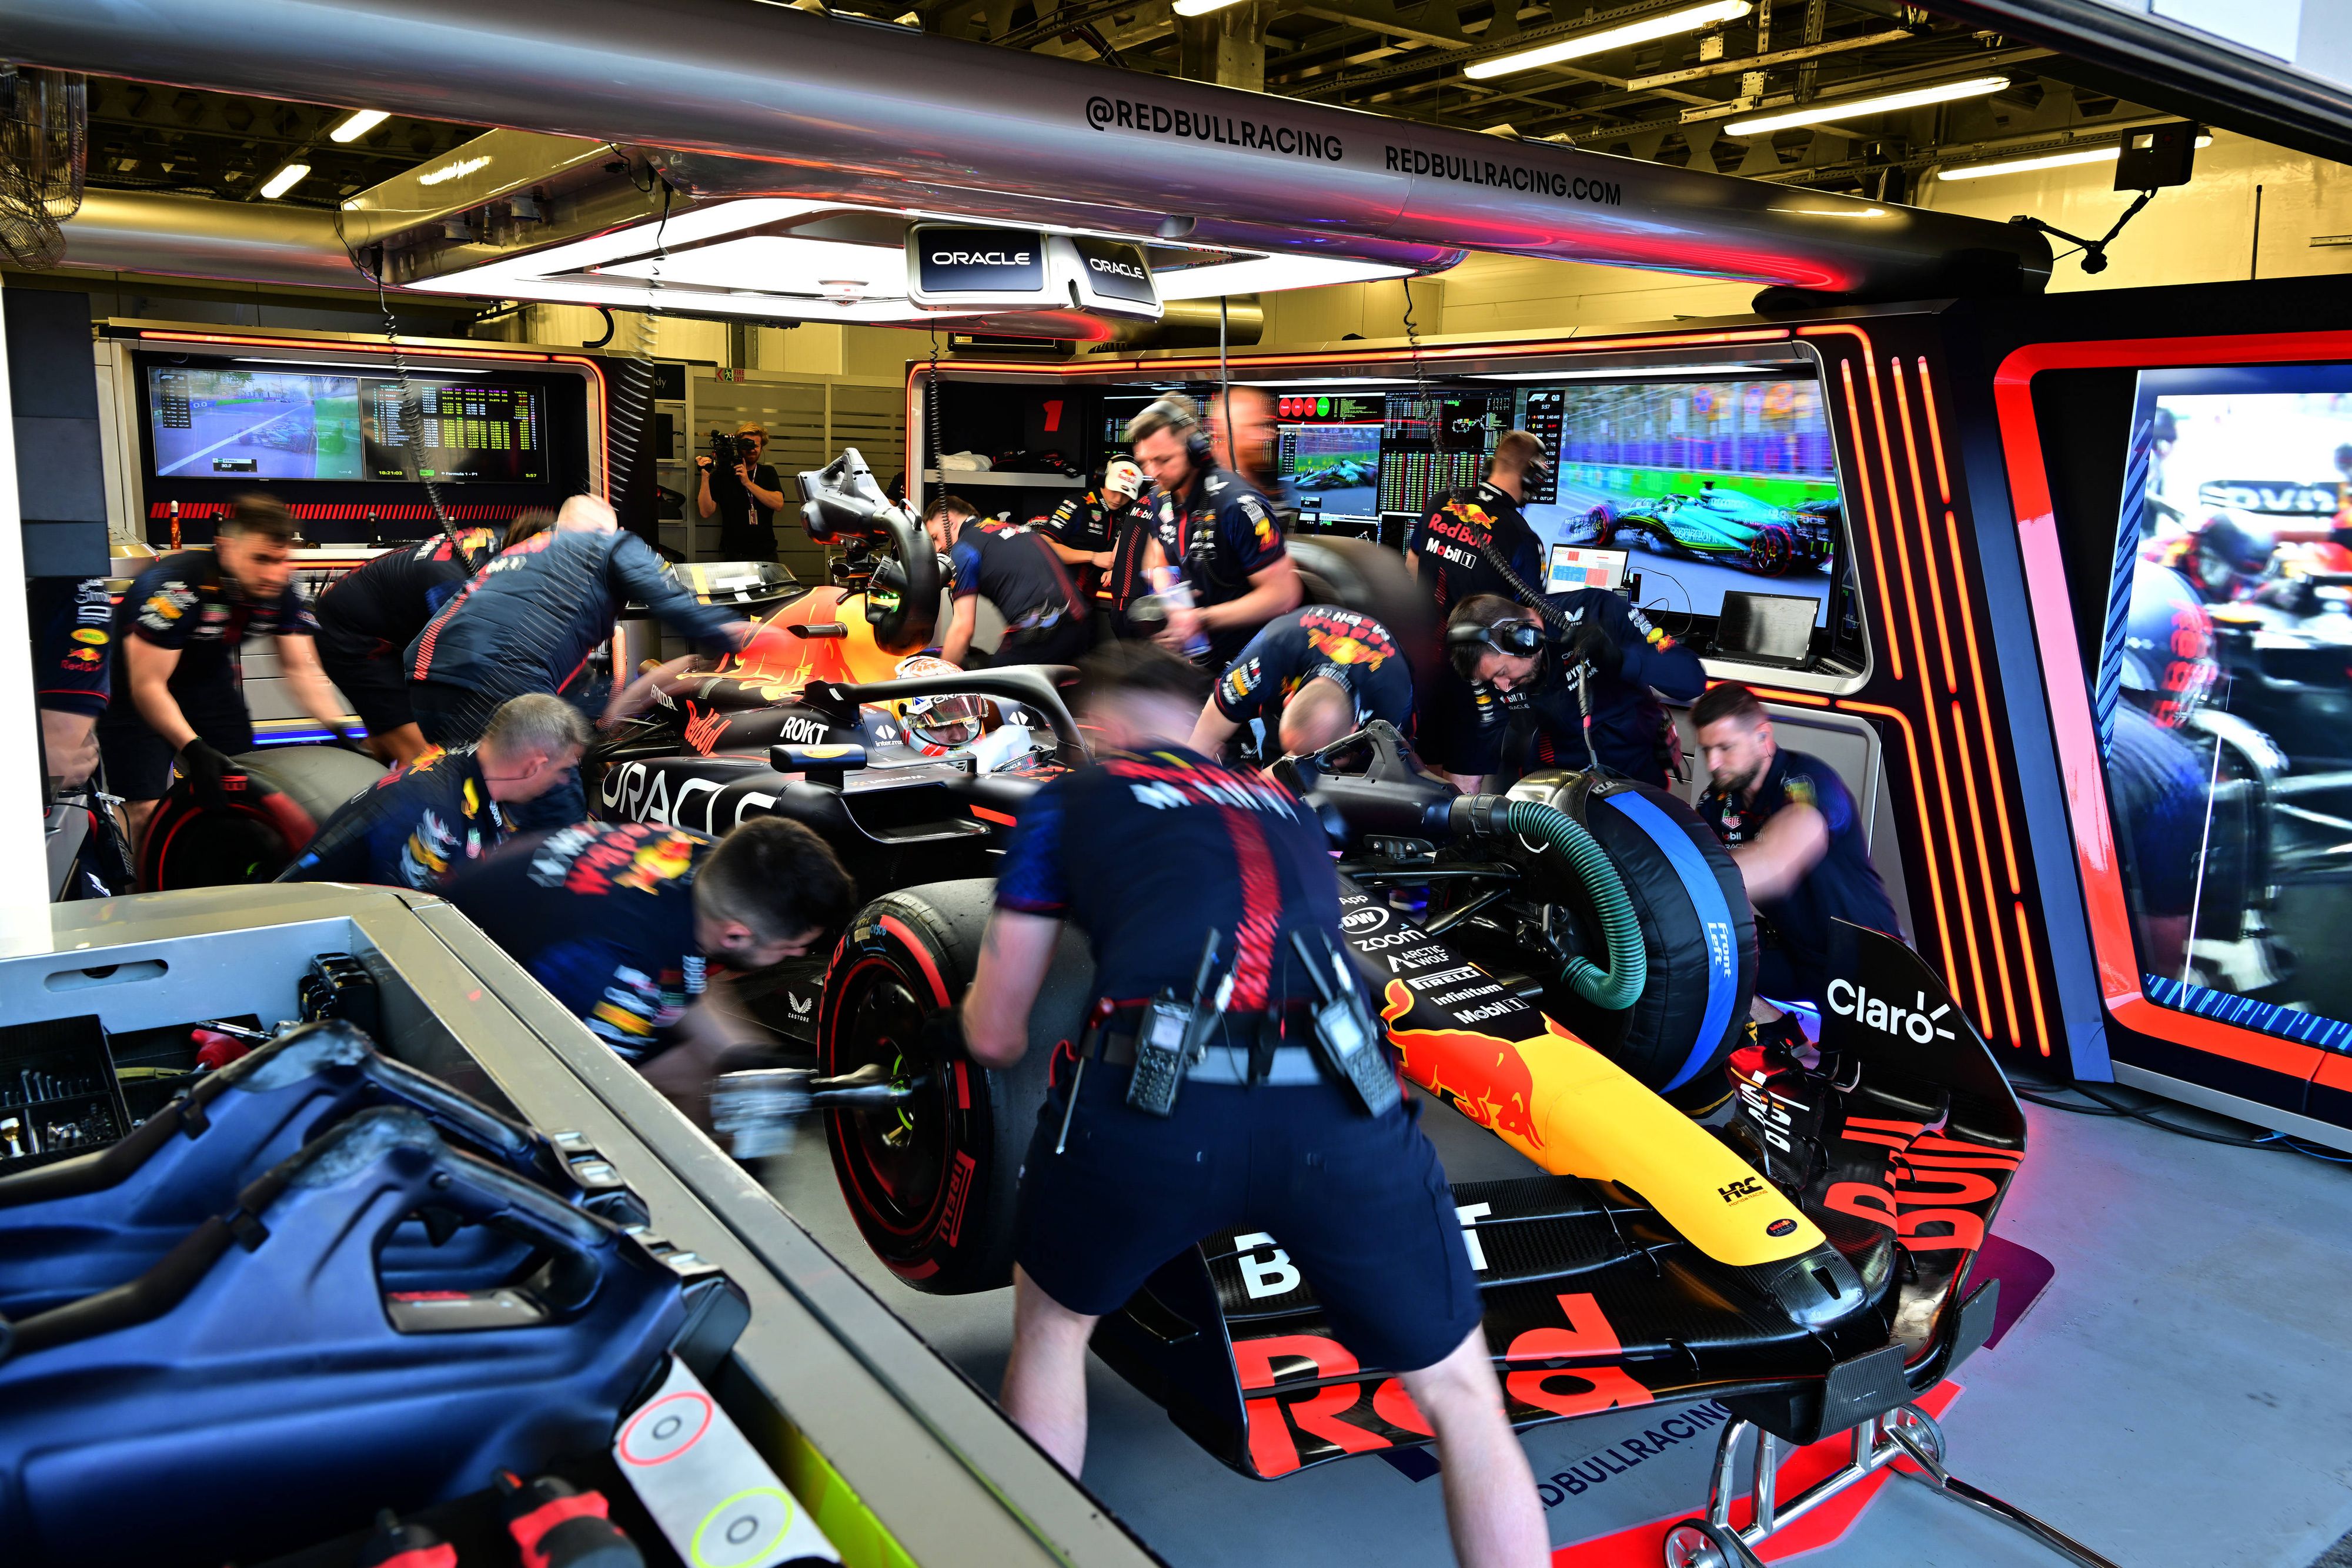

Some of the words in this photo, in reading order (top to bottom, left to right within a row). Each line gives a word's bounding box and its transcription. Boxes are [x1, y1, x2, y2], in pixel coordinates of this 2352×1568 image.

[1085, 95, 1343, 162] @REDBULLRACING
[1385, 145, 1621, 206] REDBULLRACING.COM
[932, 252, 1031, 265] ORACLE
[1090, 258, 1145, 280] ORACLE
[1043, 400, 1063, 431] 1
[1130, 507, 1154, 520] Mobil
[1426, 537, 1462, 563] Mobil
[650, 684, 679, 711] HONDA
[780, 716, 829, 745] ROKT
[1338, 895, 1369, 905] App
[1352, 930, 1427, 951] zoom
[1402, 945, 1445, 959] ARCTIC
[1706, 922, 1723, 966] Left
[1718, 922, 1731, 978] Front
[1414, 952, 1449, 967] WOLF
[1406, 966, 1481, 991] PIRELLI
[1431, 983, 1504, 1006] infinitum
[788, 1012, 809, 1023] CASTORE
[1452, 1001, 1512, 1024] Mobil
[1828, 978, 1934, 1044] Claro
[940, 1149, 975, 1249] PIRELLI
[1717, 1176, 1764, 1203] HRC
[1729, 1197, 1749, 1208] Honda
[1748, 1190, 1768, 1199] RACING
